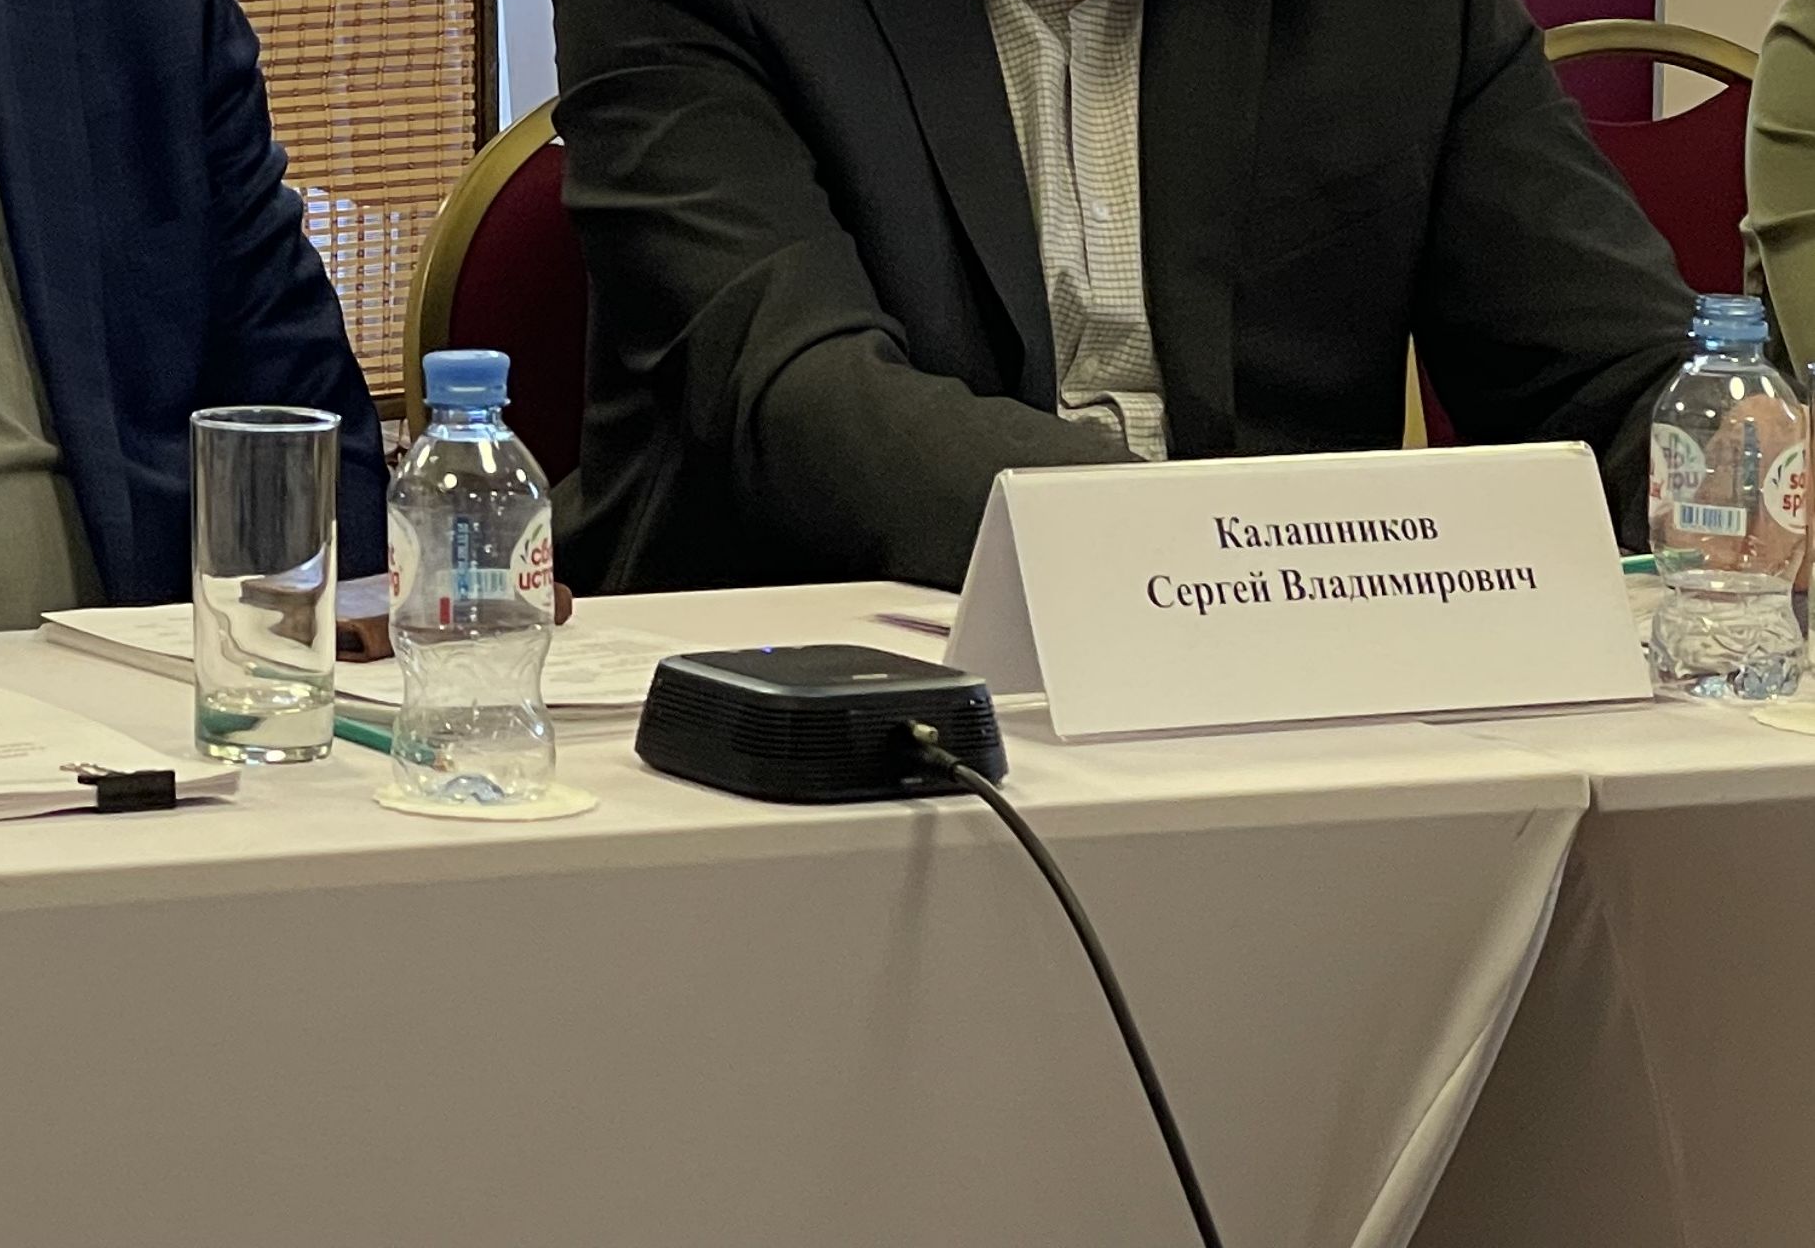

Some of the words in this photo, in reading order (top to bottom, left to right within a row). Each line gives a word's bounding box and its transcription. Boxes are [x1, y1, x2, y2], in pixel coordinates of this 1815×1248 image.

[1213, 516, 1439, 549] Калашников
[1146, 570, 1272, 616] Сергей
[1278, 566, 1538, 604] Владимирович
